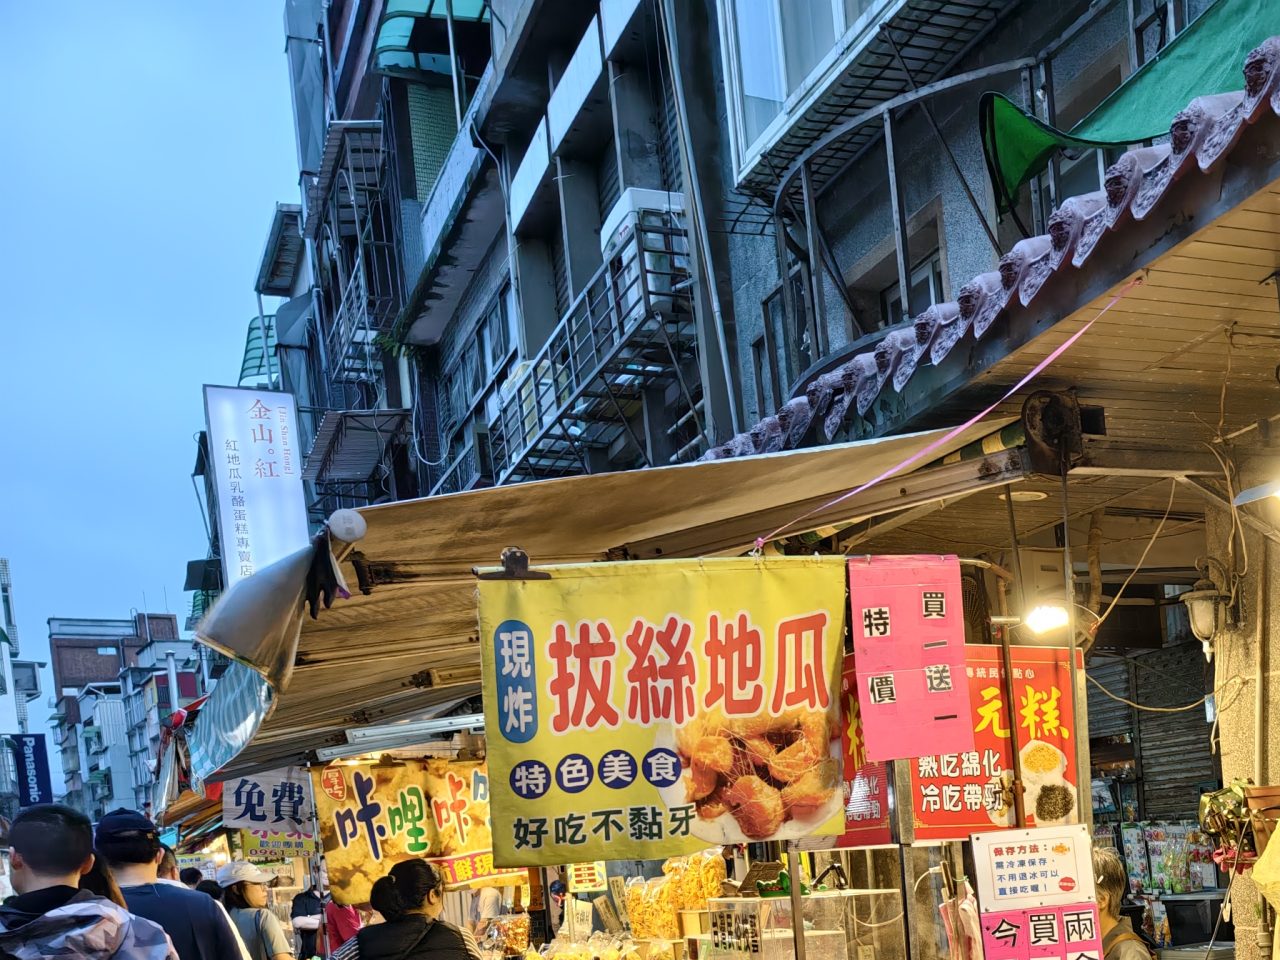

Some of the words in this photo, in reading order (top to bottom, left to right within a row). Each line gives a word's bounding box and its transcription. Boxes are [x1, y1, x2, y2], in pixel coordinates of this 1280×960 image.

[499, 630, 533, 734] 現炸
[547, 612, 830, 733] 拔絲地瓜
[863, 608, 896, 704] 特價
[923, 591, 958, 720] 買一送一
[22, 736, 42, 802] Panasonic
[514, 750, 680, 798] 特色美食
[918, 750, 1001, 779] 熱吃綿化
[513, 804, 696, 850] 好吃不黏牙
[921, 784, 1003, 813] 冷吃帶勁
[997, 869, 1060, 882] 不用退冰可以
